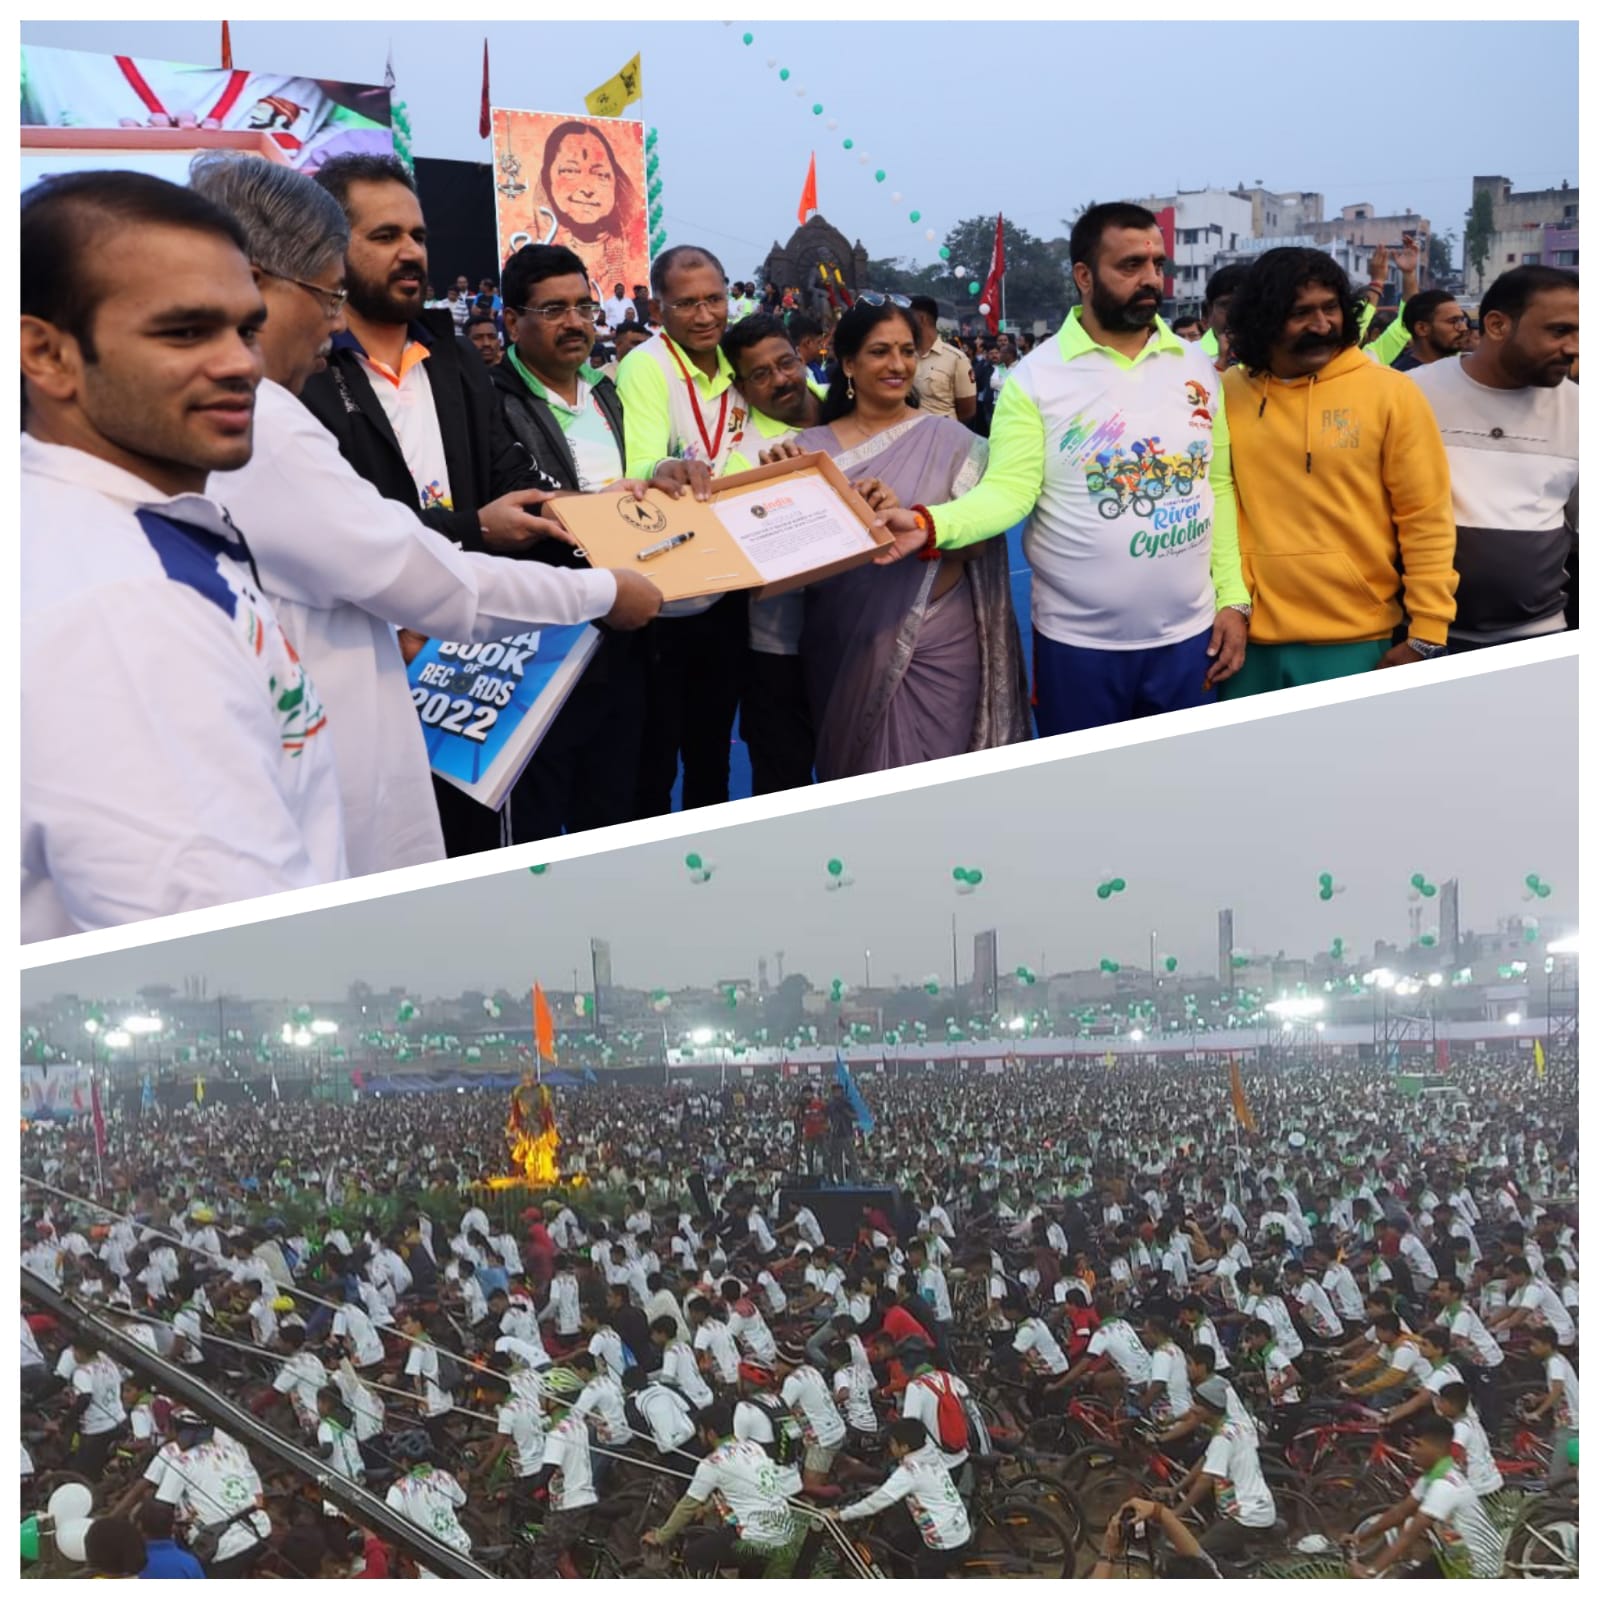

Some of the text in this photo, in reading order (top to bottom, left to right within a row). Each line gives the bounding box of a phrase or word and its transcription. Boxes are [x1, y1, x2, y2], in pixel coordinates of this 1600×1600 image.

[1153, 502, 1201, 530] River
[438, 641, 535, 676] BOOK
[463, 662, 483, 674] OF
[411, 687, 498, 741] 2022
